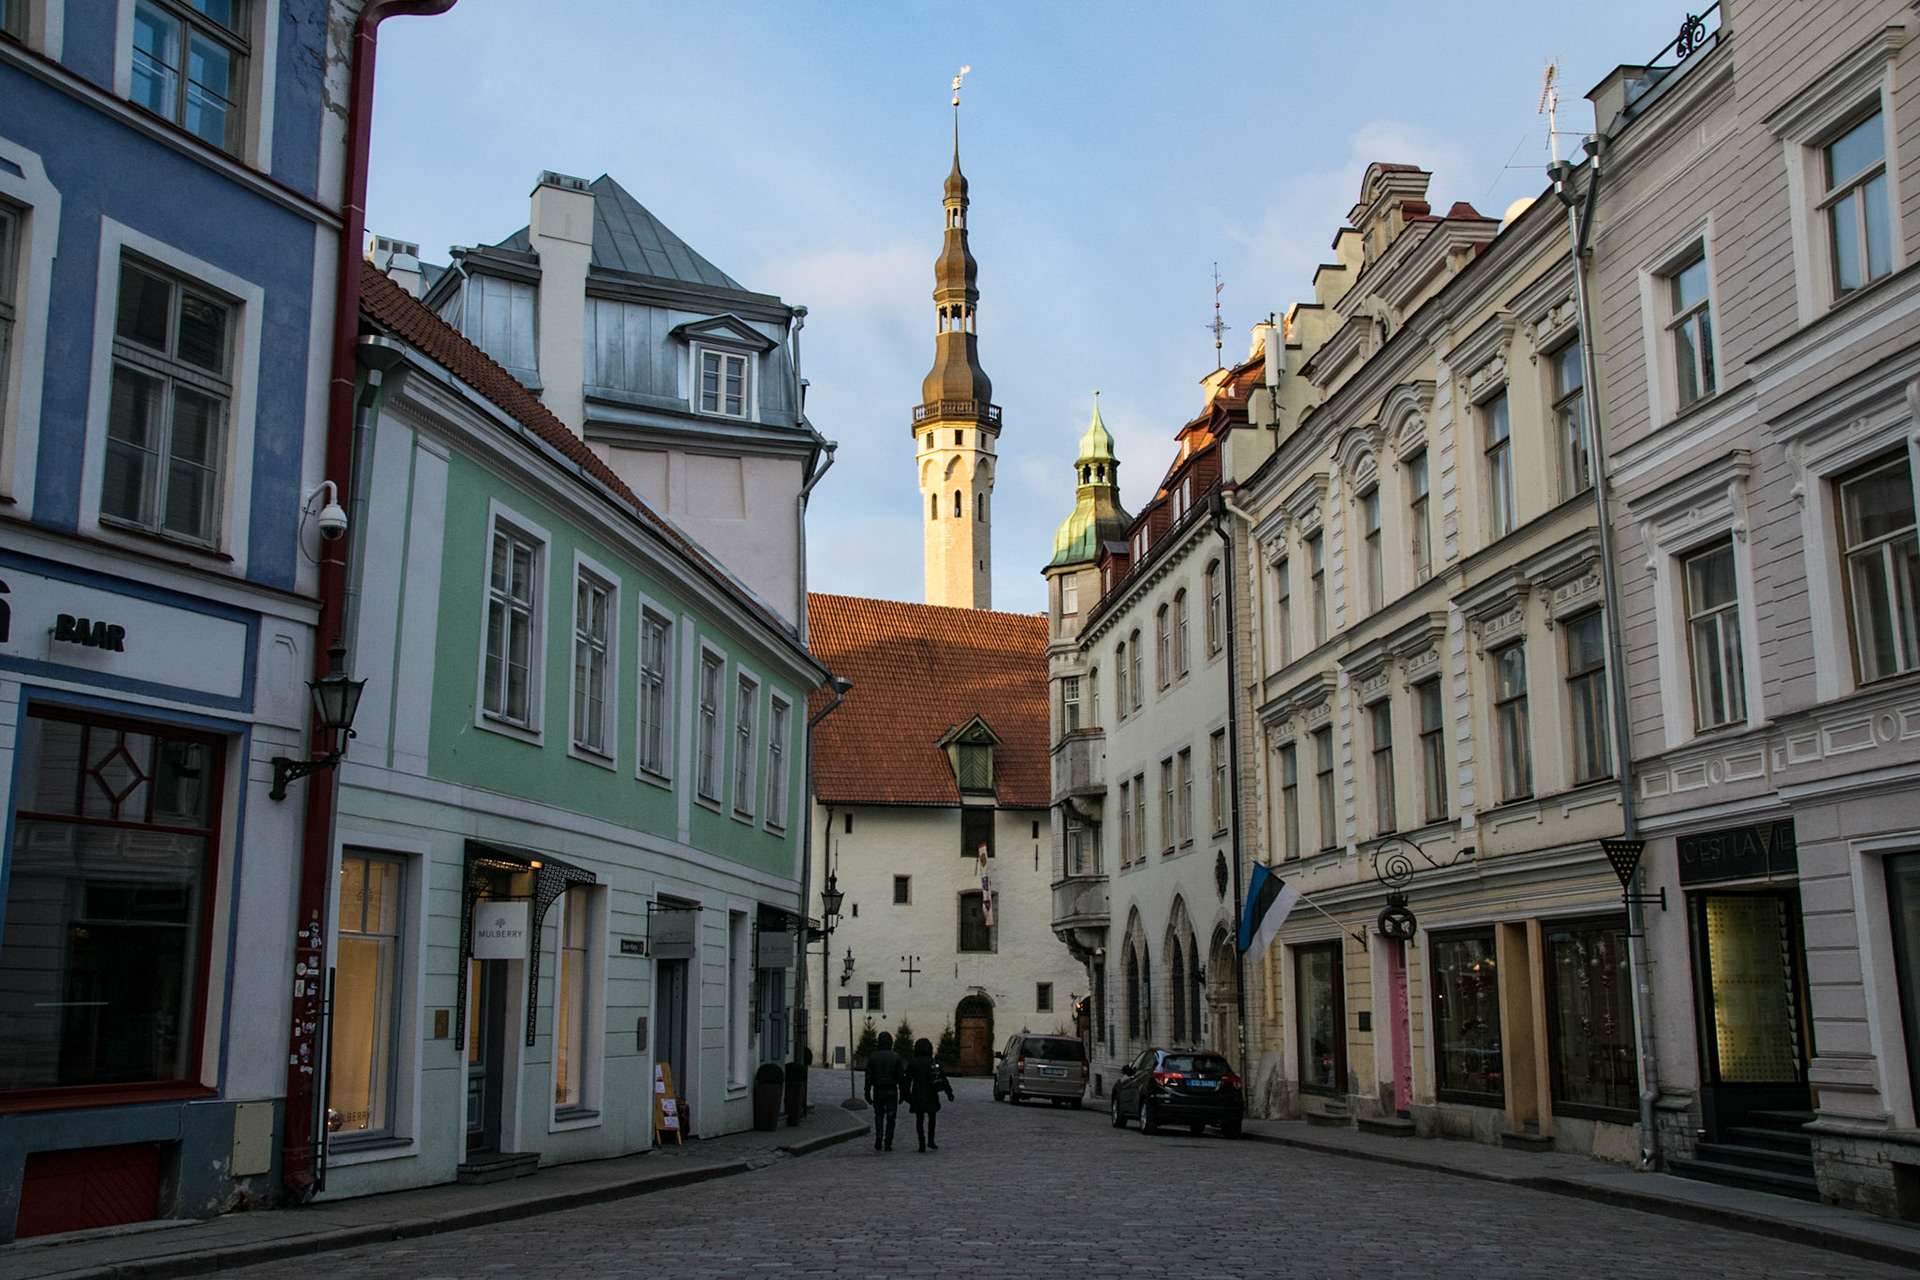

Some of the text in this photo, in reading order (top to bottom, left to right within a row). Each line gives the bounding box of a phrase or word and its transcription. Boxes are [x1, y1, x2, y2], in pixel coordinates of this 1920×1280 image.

[55, 613, 125, 652] BAAR
[1734, 832, 1758, 858] LA
[478, 930, 524, 938] MULBERRY
